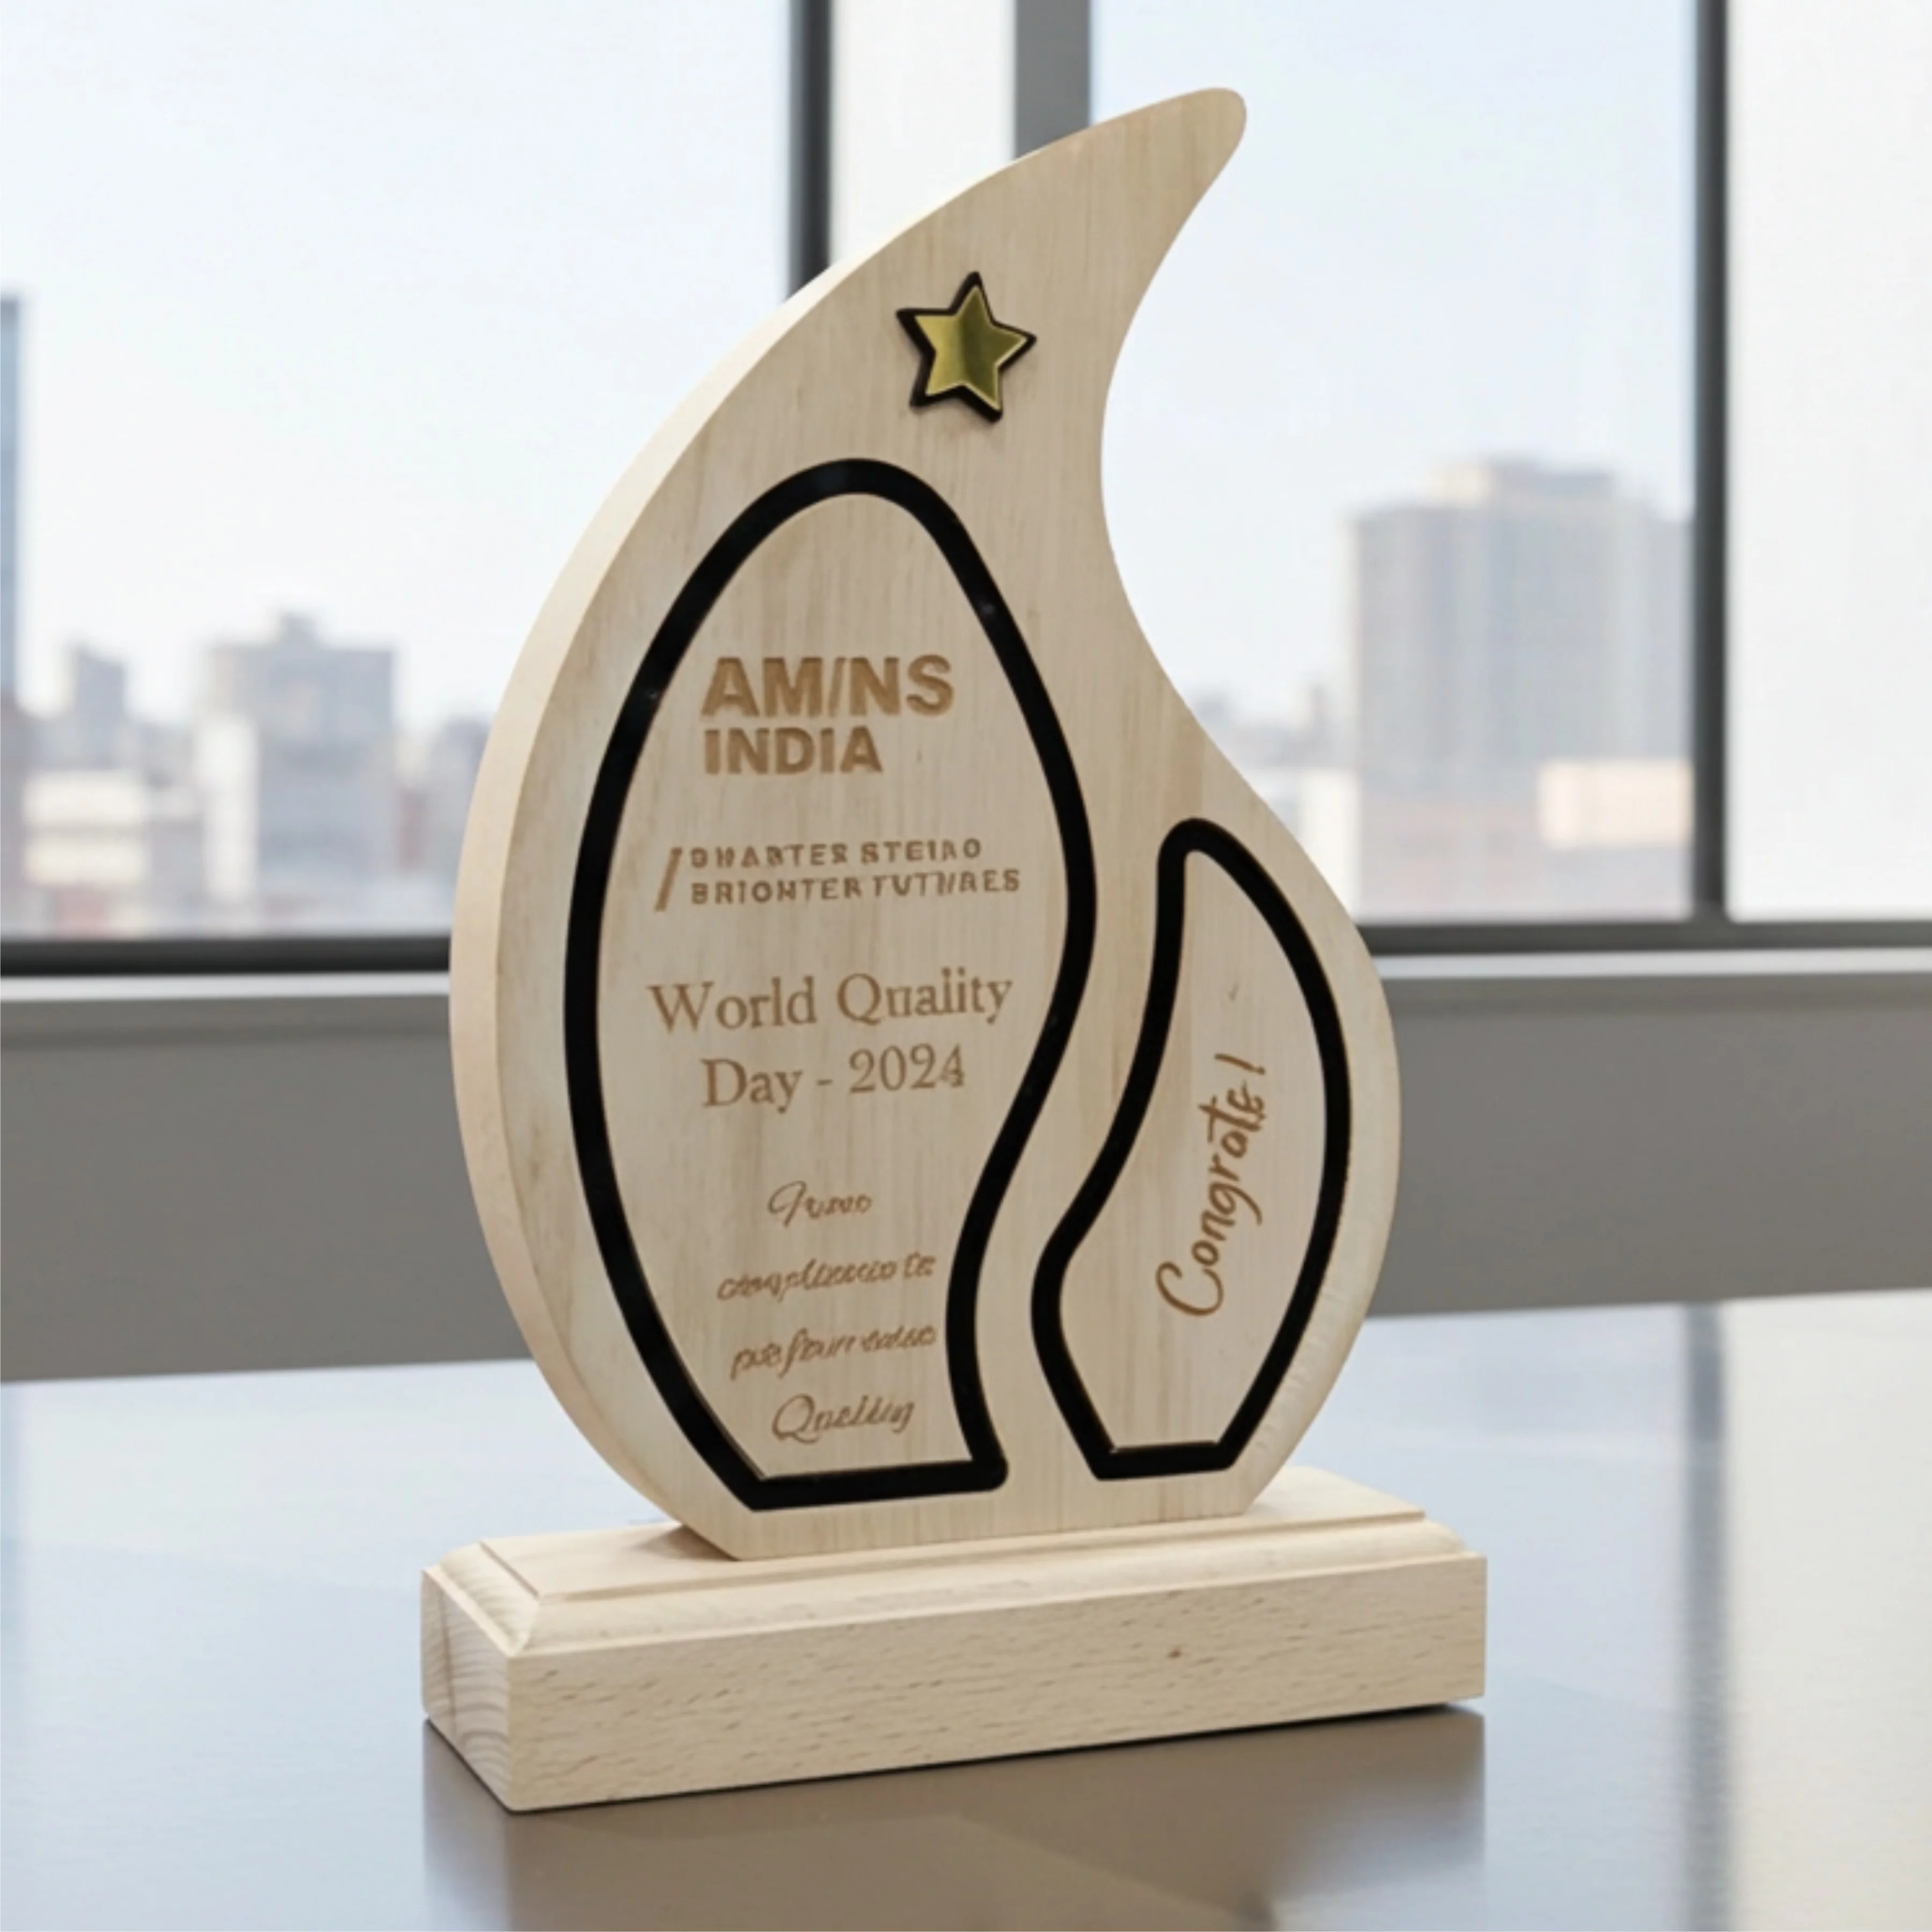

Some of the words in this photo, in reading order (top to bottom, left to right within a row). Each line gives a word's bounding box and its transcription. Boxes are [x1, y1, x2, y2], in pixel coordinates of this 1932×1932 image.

[701, 654, 955, 717] AM/NS
[704, 726, 884, 775] INDIA
[646, 975, 818, 1034] World
[836, 966, 1013, 1027] Quality
[700, 1058, 803, 1114] Day
[849, 1043, 966, 1095] 2024
